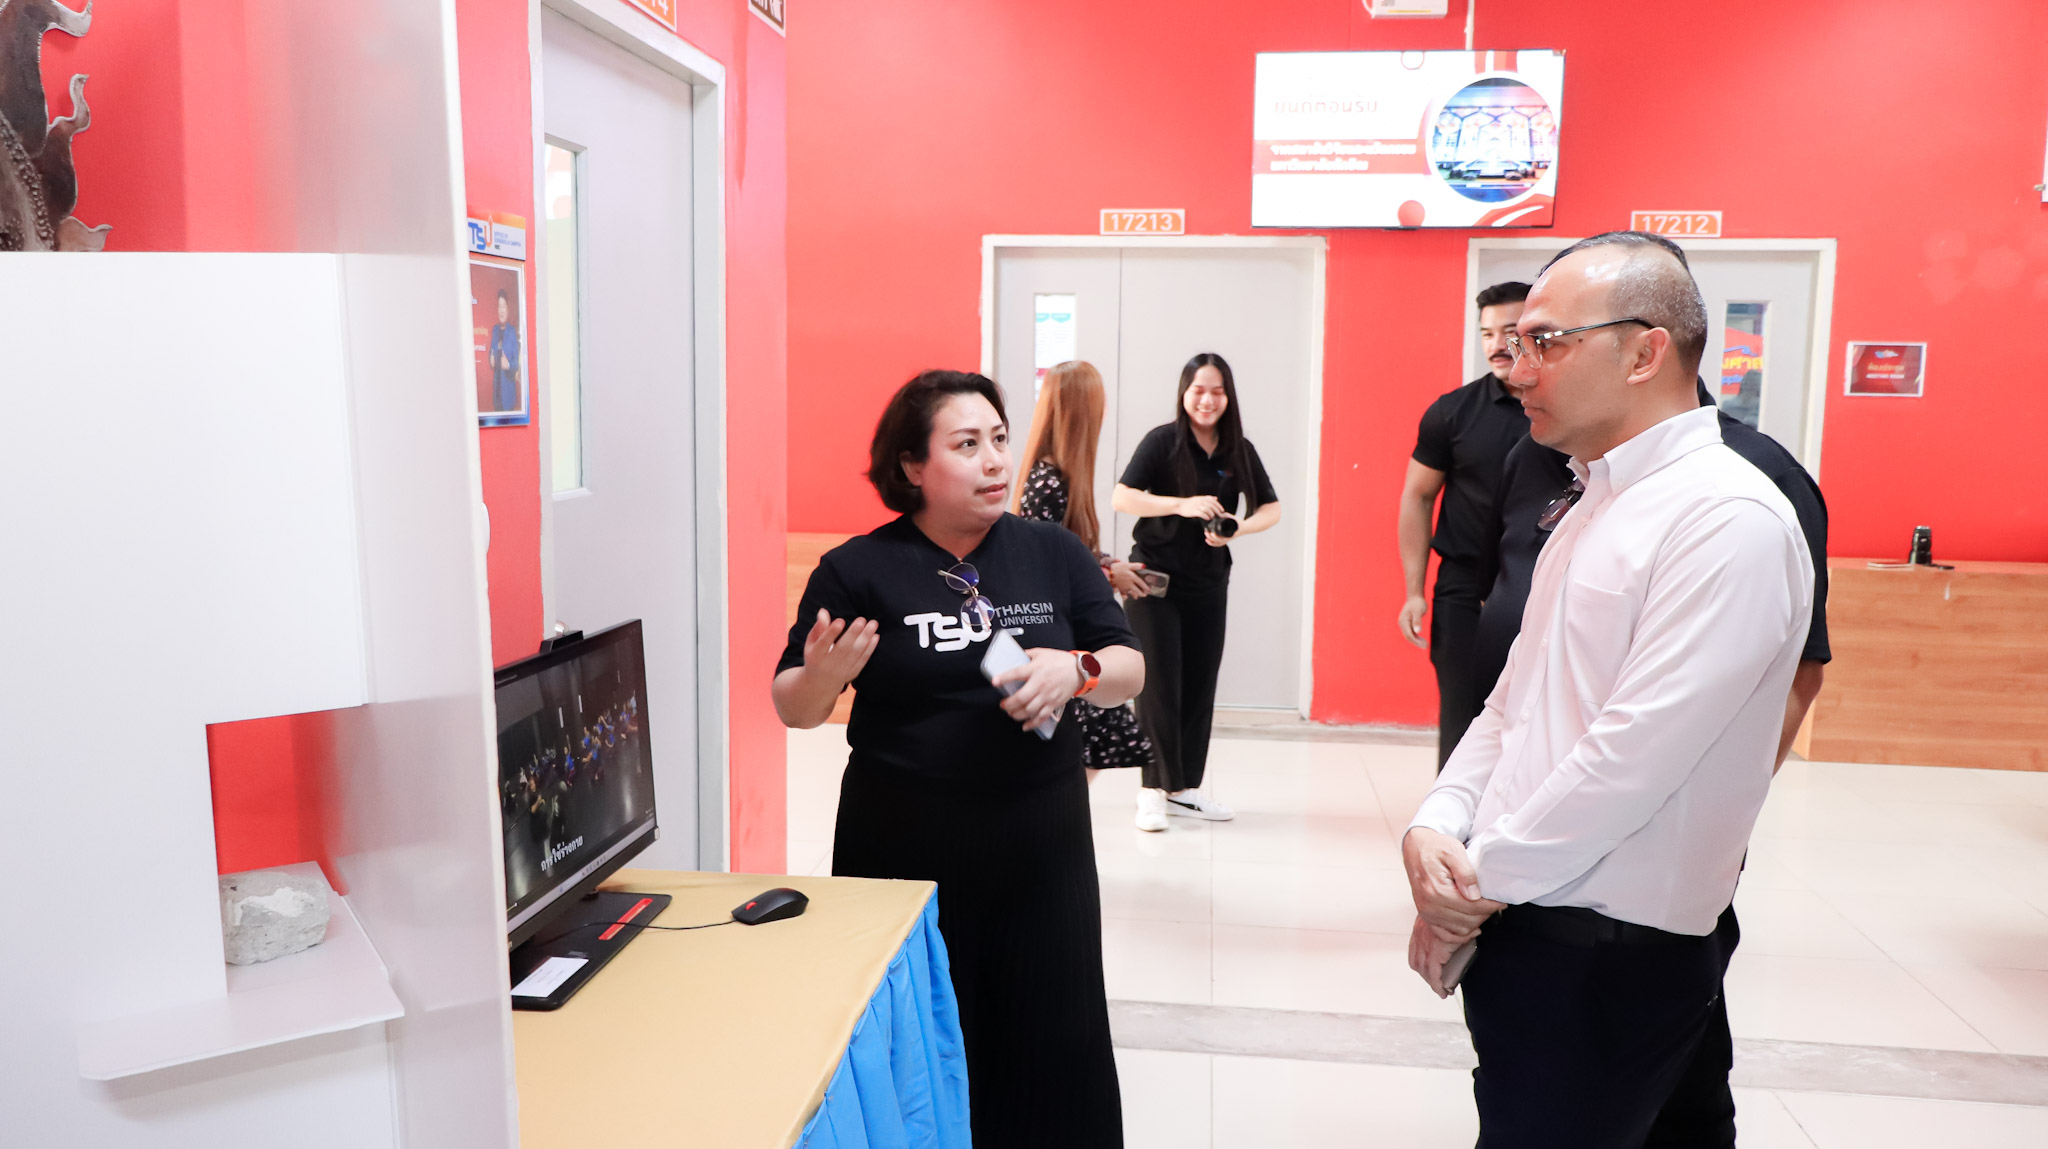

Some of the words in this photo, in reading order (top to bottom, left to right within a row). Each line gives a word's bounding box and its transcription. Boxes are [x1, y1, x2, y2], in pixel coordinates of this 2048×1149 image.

[1111, 213, 1173, 231] 17213
[1642, 215, 1709, 233] 17212
[468, 216, 493, 250] TSU
[994, 602, 1054, 618] THAKSIN
[903, 600, 992, 652] TSU
[1000, 615, 1054, 628] UNIVERSITY
